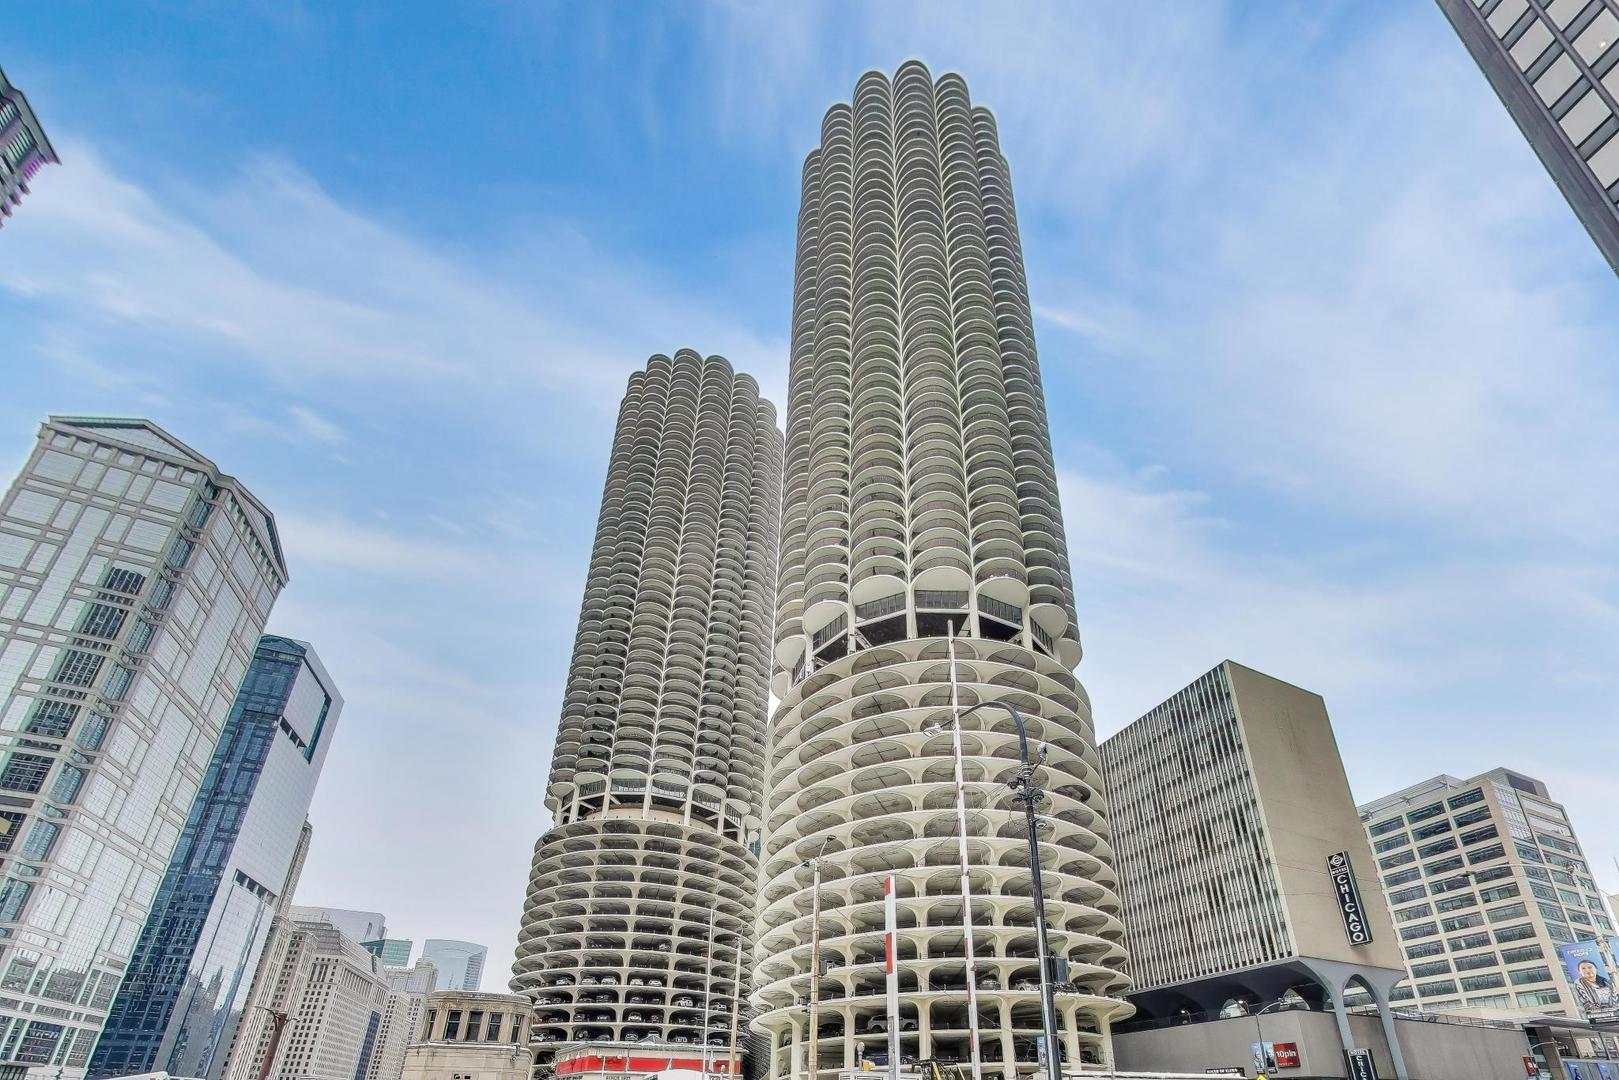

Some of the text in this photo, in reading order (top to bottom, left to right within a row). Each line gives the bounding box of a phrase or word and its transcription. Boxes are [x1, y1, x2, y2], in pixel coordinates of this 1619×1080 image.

[1337, 875, 1364, 942] CHICAGO
[1276, 1049, 1296, 1058] 10pin
[1356, 1055, 1369, 1080] CHIC
